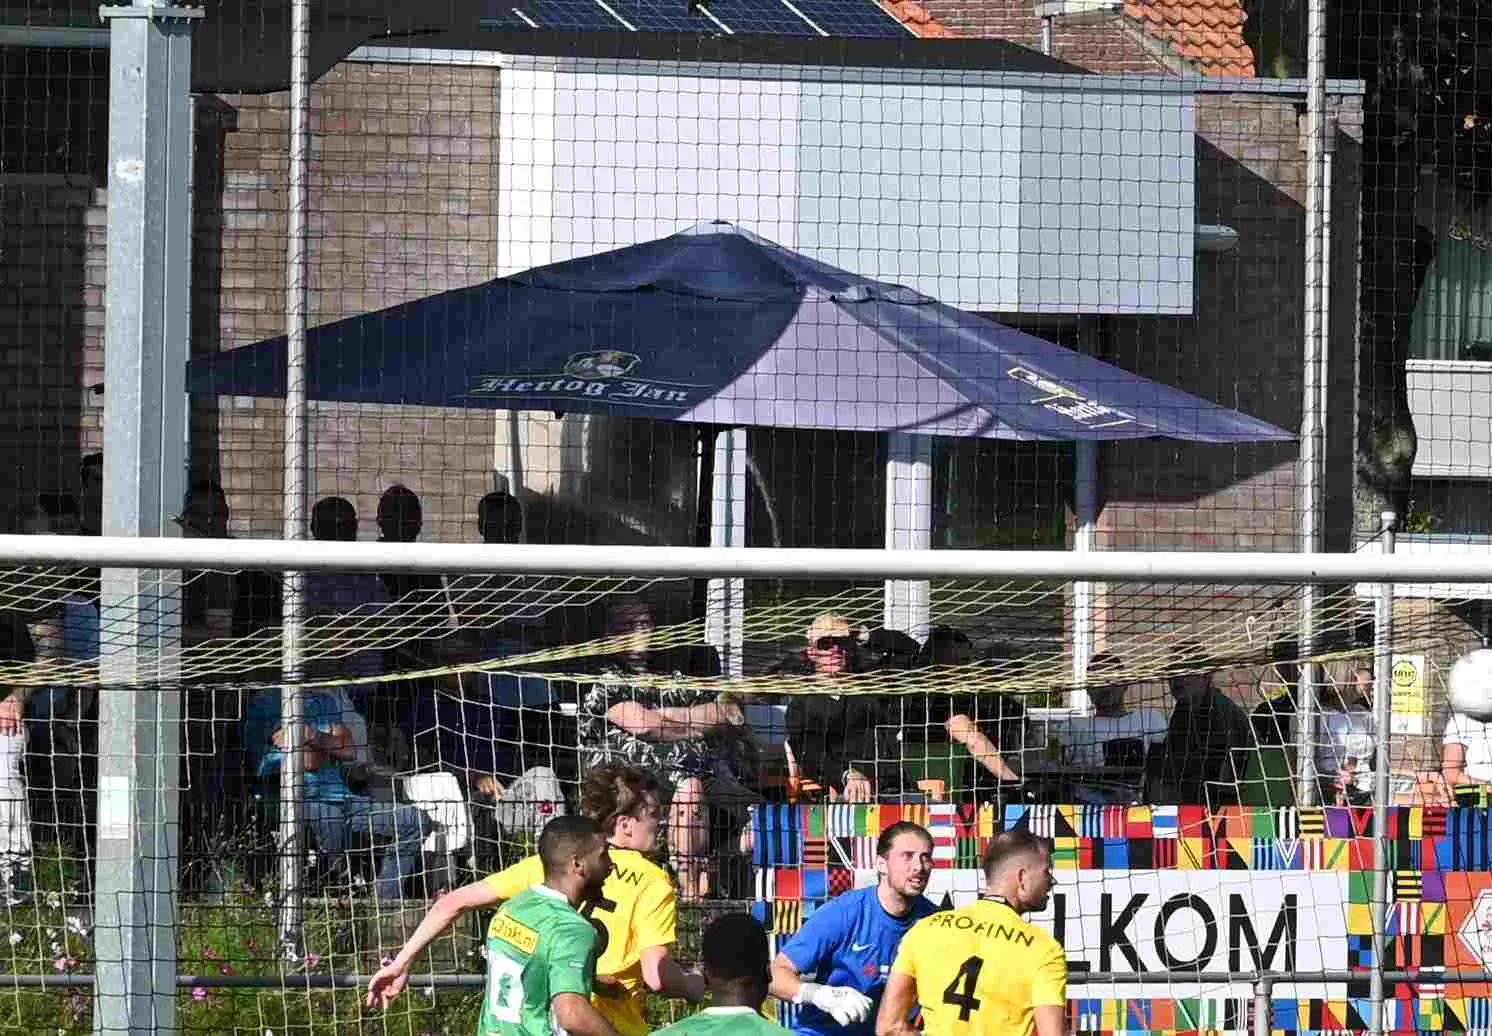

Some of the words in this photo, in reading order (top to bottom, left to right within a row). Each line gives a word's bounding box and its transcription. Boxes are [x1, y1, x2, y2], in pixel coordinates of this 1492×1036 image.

[471, 378, 612, 396] Hertog
[608, 380, 688, 402] Jan
[929, 912, 1034, 948] PROFINN
[943, 955, 983, 1020] 4
